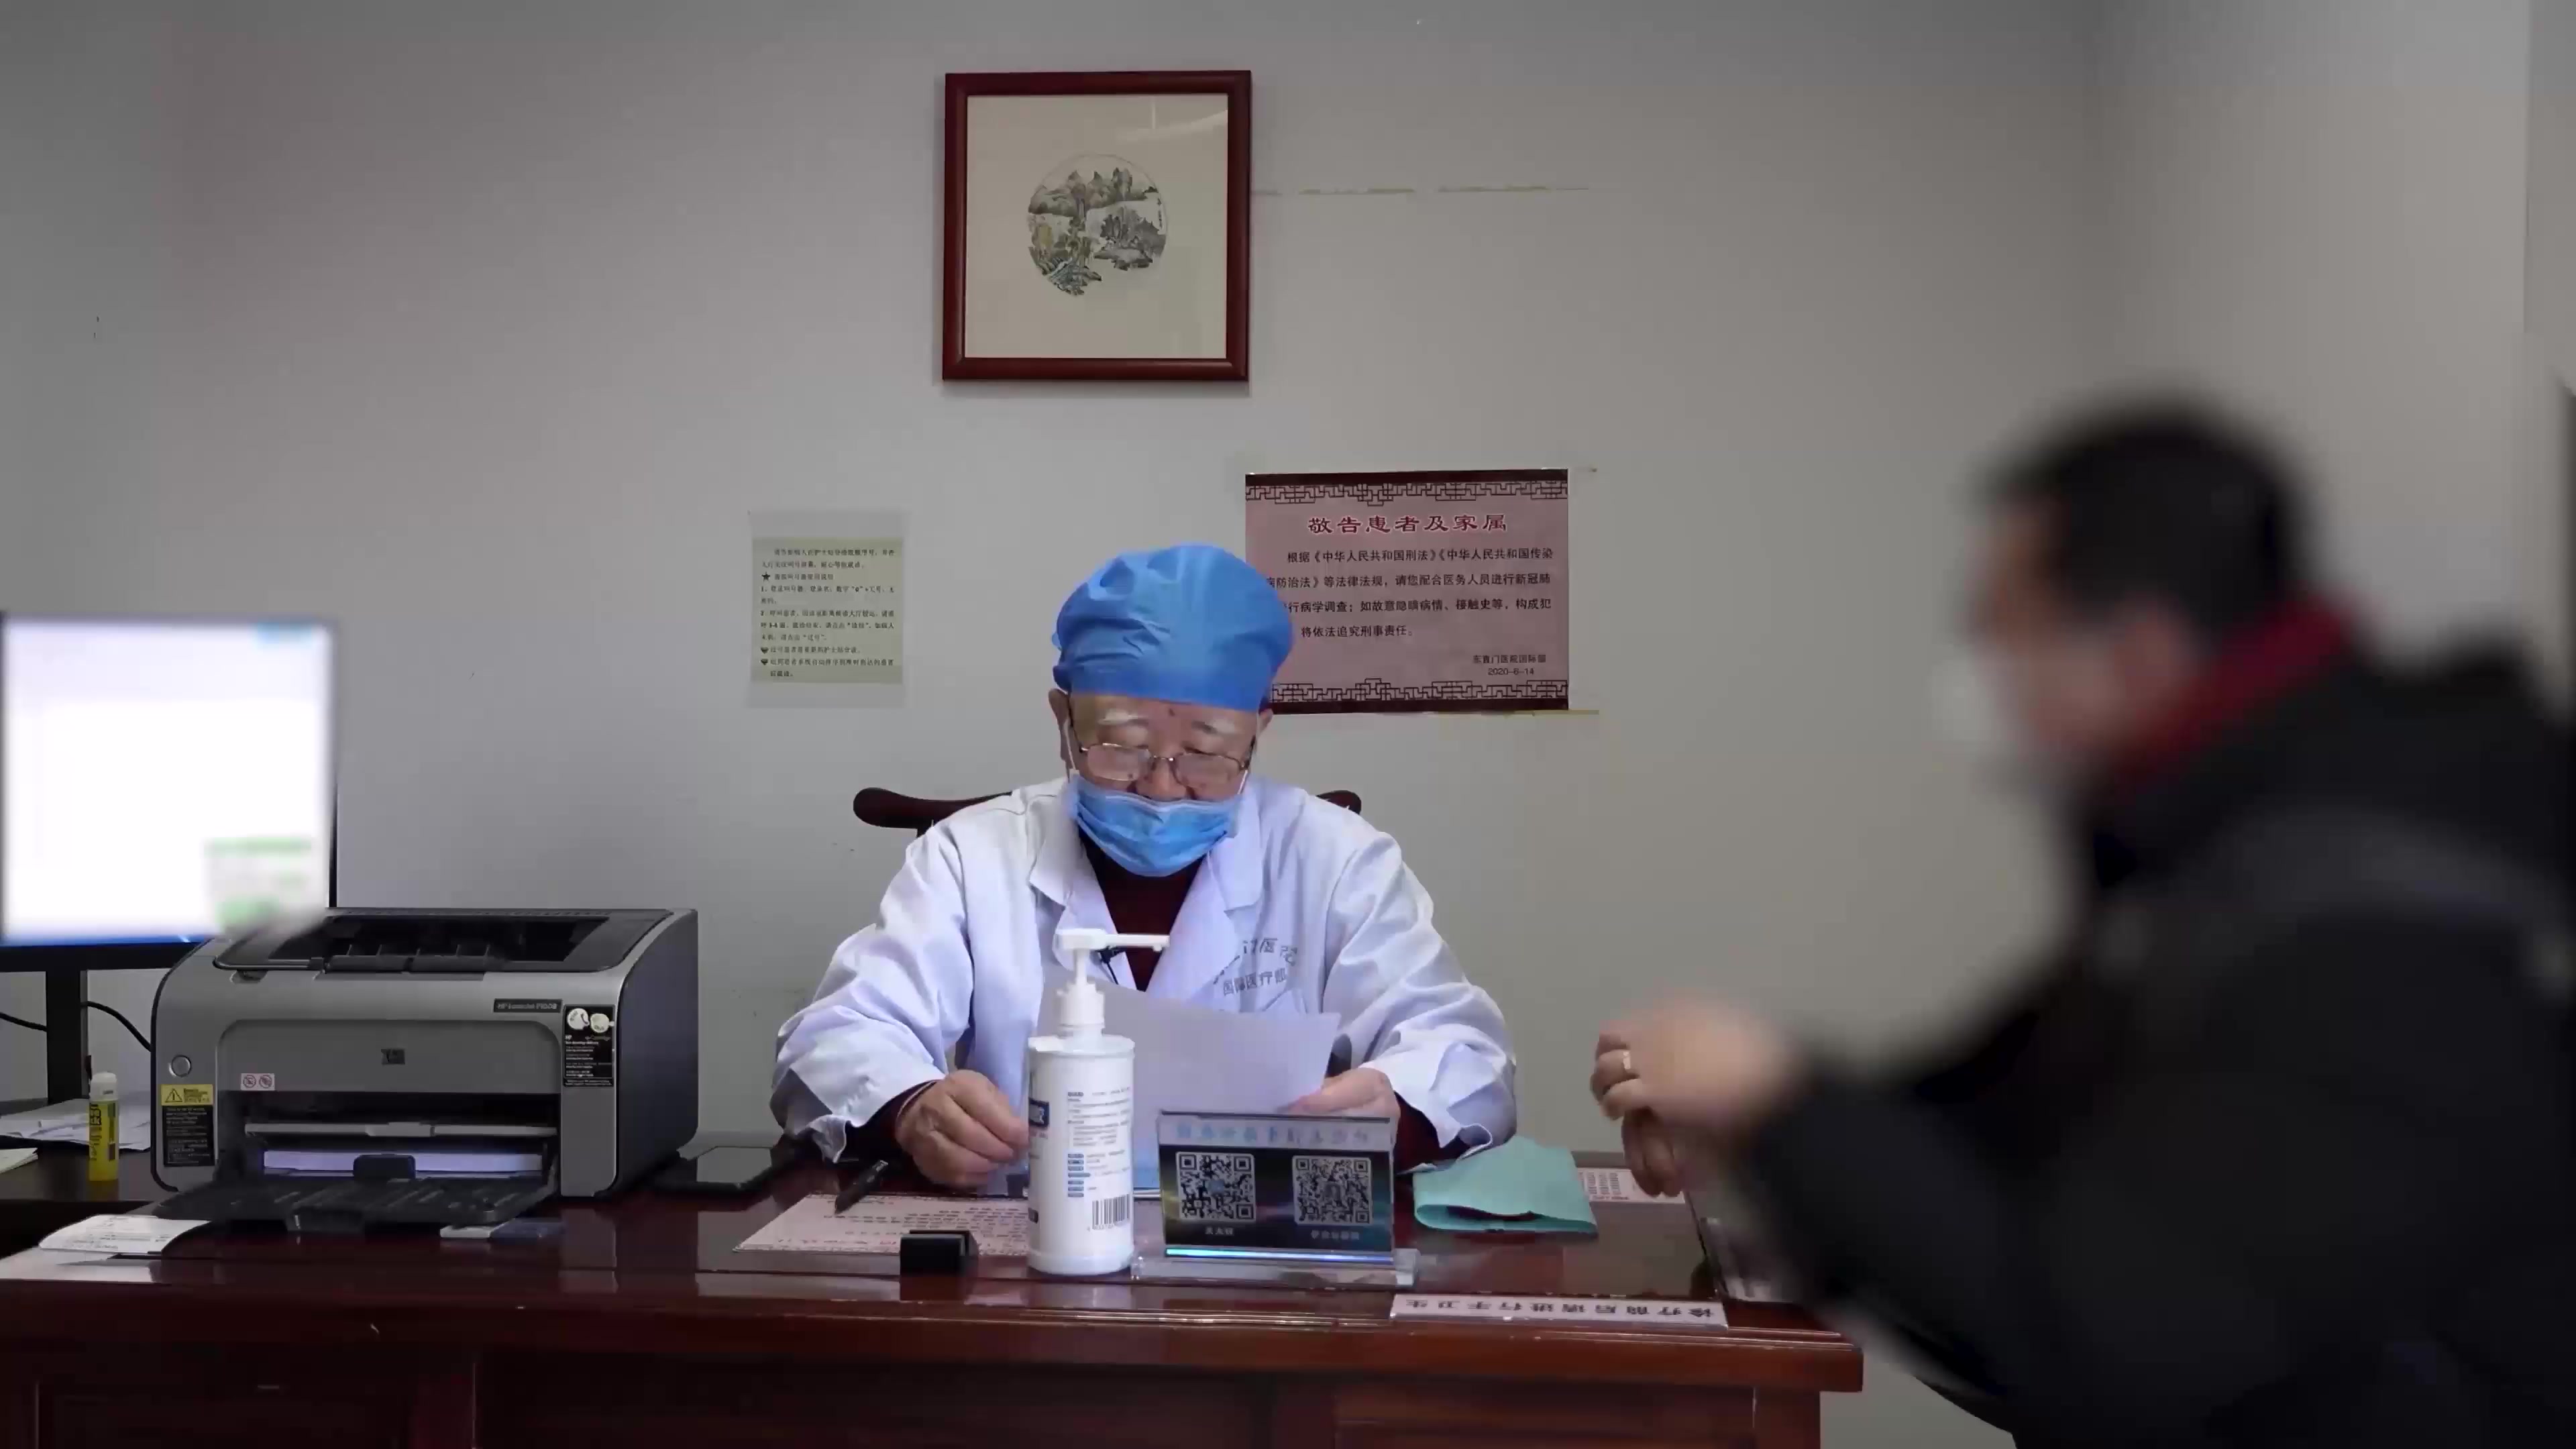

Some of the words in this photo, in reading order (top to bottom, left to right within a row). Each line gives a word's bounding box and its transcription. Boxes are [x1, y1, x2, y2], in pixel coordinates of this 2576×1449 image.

[1307, 514, 1507, 535] 敬告患者及家属
[1287, 547, 1553, 564] 根据《中华人民共和国刑法》《中华人民共和国传染
[1283, 598, 1551, 613] 行病学调查；如故意隐瞒病情、接触史等，构成犯
[1301, 625, 1413, 637] 将依法追究刑事责任。
